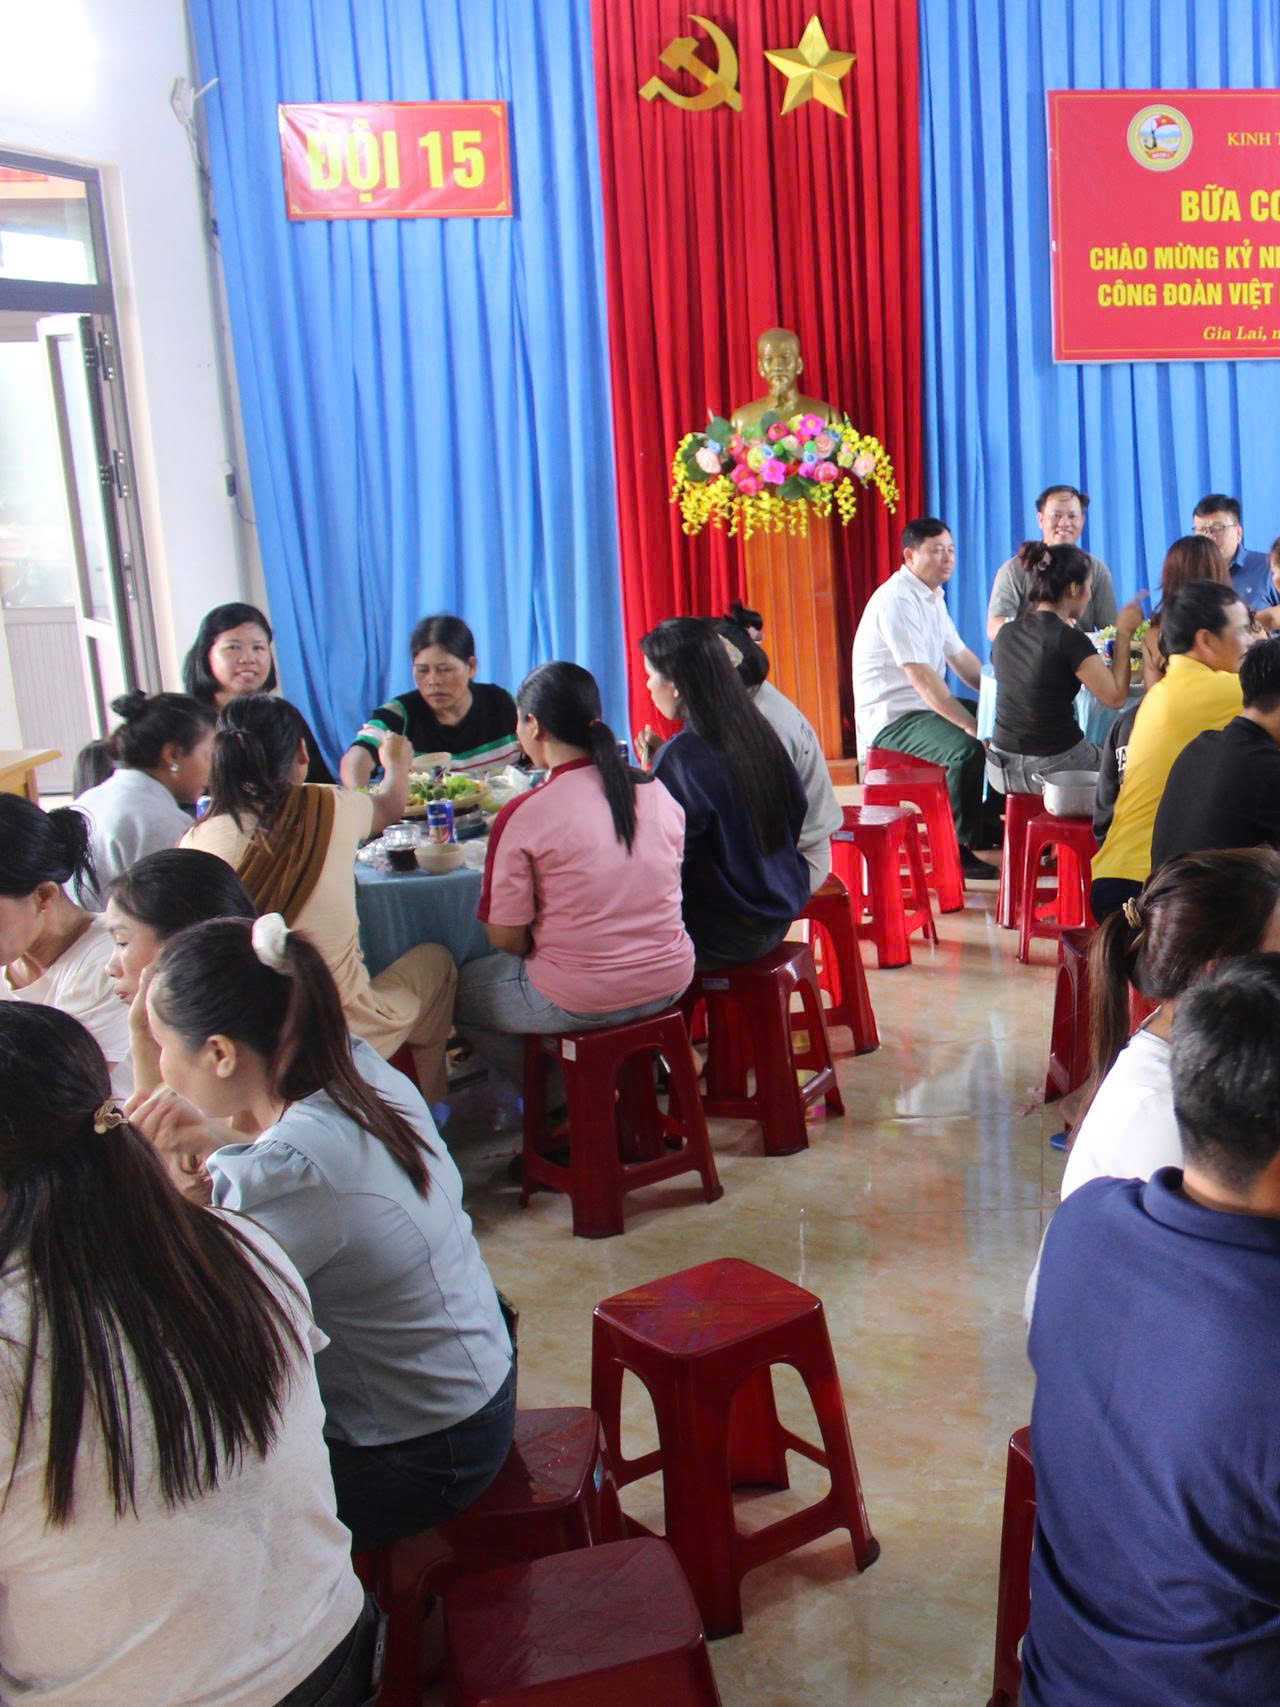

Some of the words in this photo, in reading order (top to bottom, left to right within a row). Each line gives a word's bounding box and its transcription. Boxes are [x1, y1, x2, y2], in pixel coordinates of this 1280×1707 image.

[1227, 132, 1272, 146] KINH
[305, 118, 400, 203] ĐỘI
[418, 130, 486, 190] 15
[1181, 184, 1242, 222] BỮA
[1089, 243, 1148, 270] CHÀO
[1154, 242, 1219, 270] MỪNG
[1225, 239, 1253, 269] KỶ
[1097, 279, 1158, 307] CÔNG
[1163, 278, 1222, 306] ĐOÀN
[1228, 278, 1274, 310] VIỆT
[1203, 326, 1232, 340] Gia
[1237, 326, 1267, 343] Lai,
